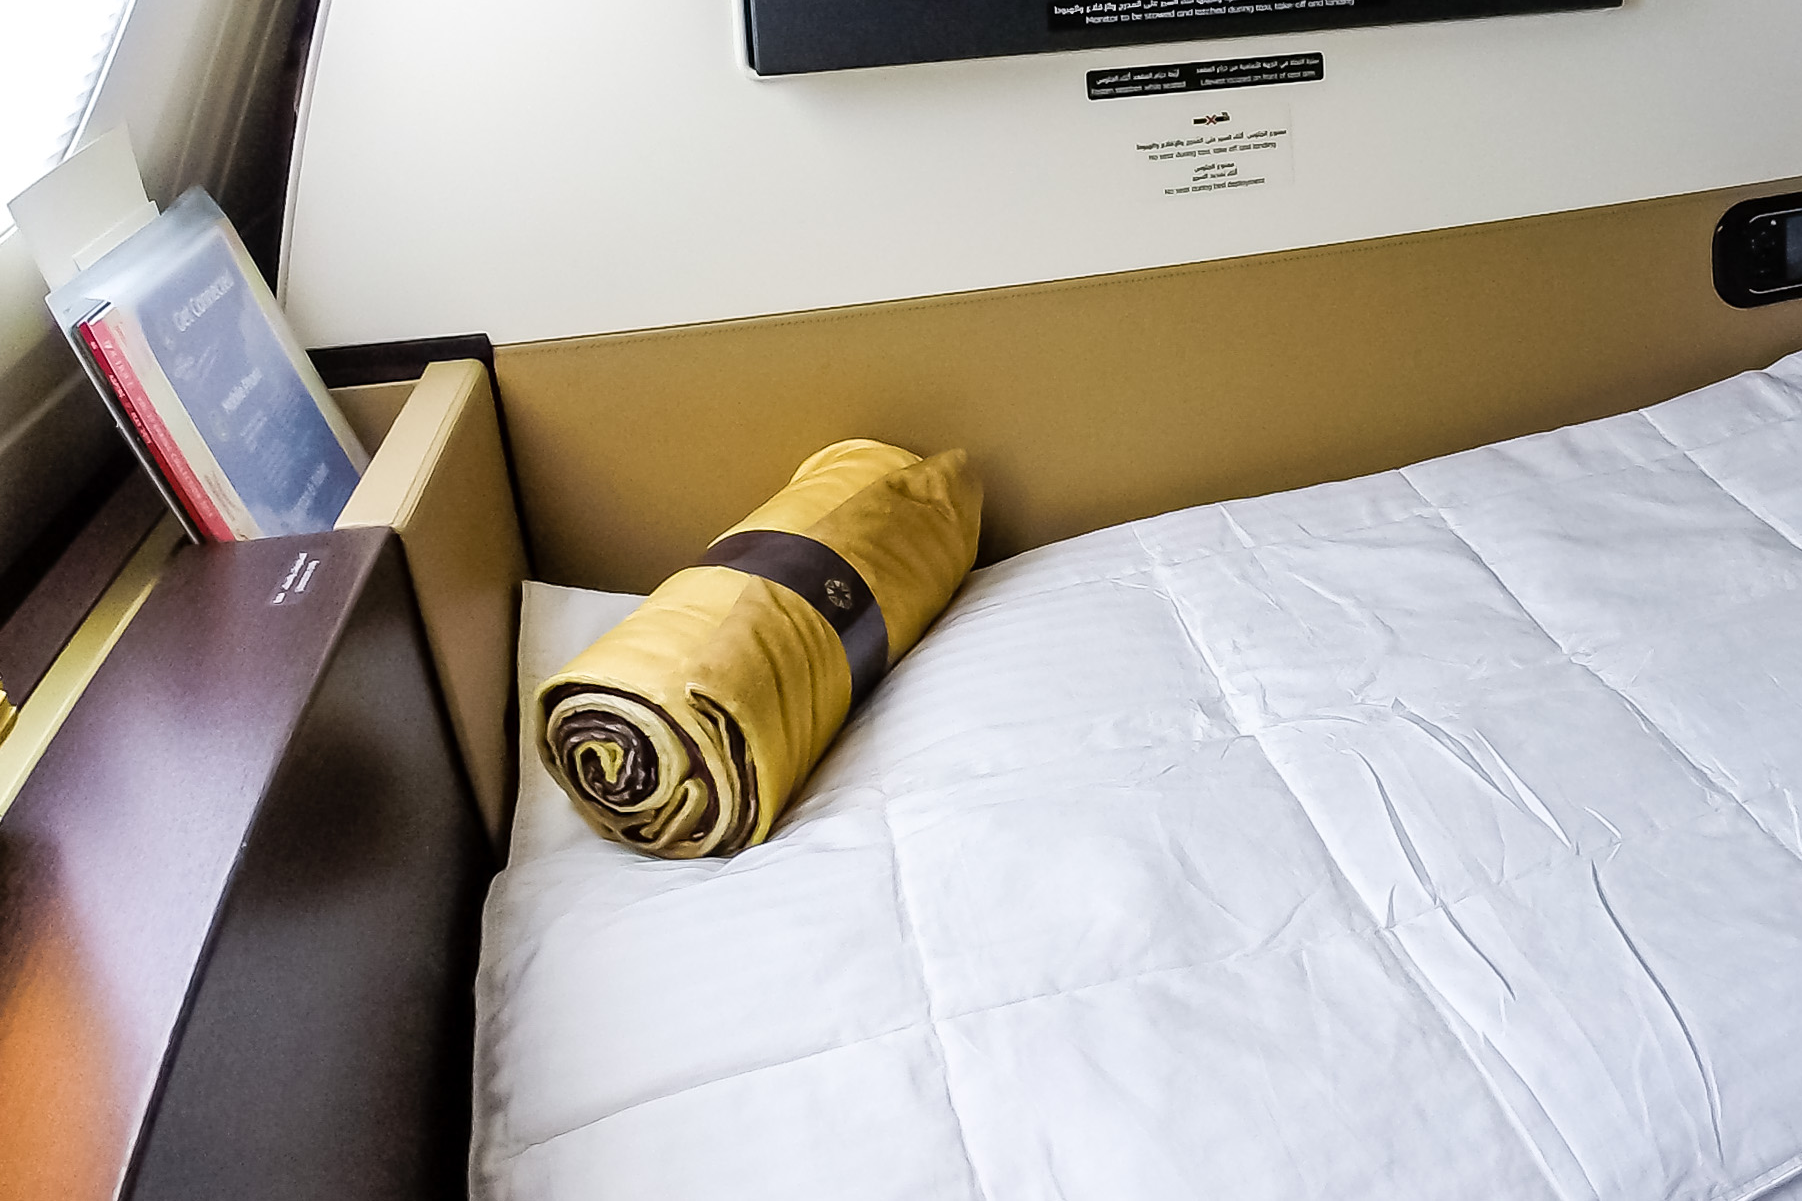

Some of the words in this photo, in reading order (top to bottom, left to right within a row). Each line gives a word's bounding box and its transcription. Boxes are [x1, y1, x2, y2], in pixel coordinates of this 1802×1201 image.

[1120, 14, 1130, 22] to
[1131, 12, 1143, 21] be
[1177, 9, 1193, 18] and
[1308, 0, 1323, 8] and
